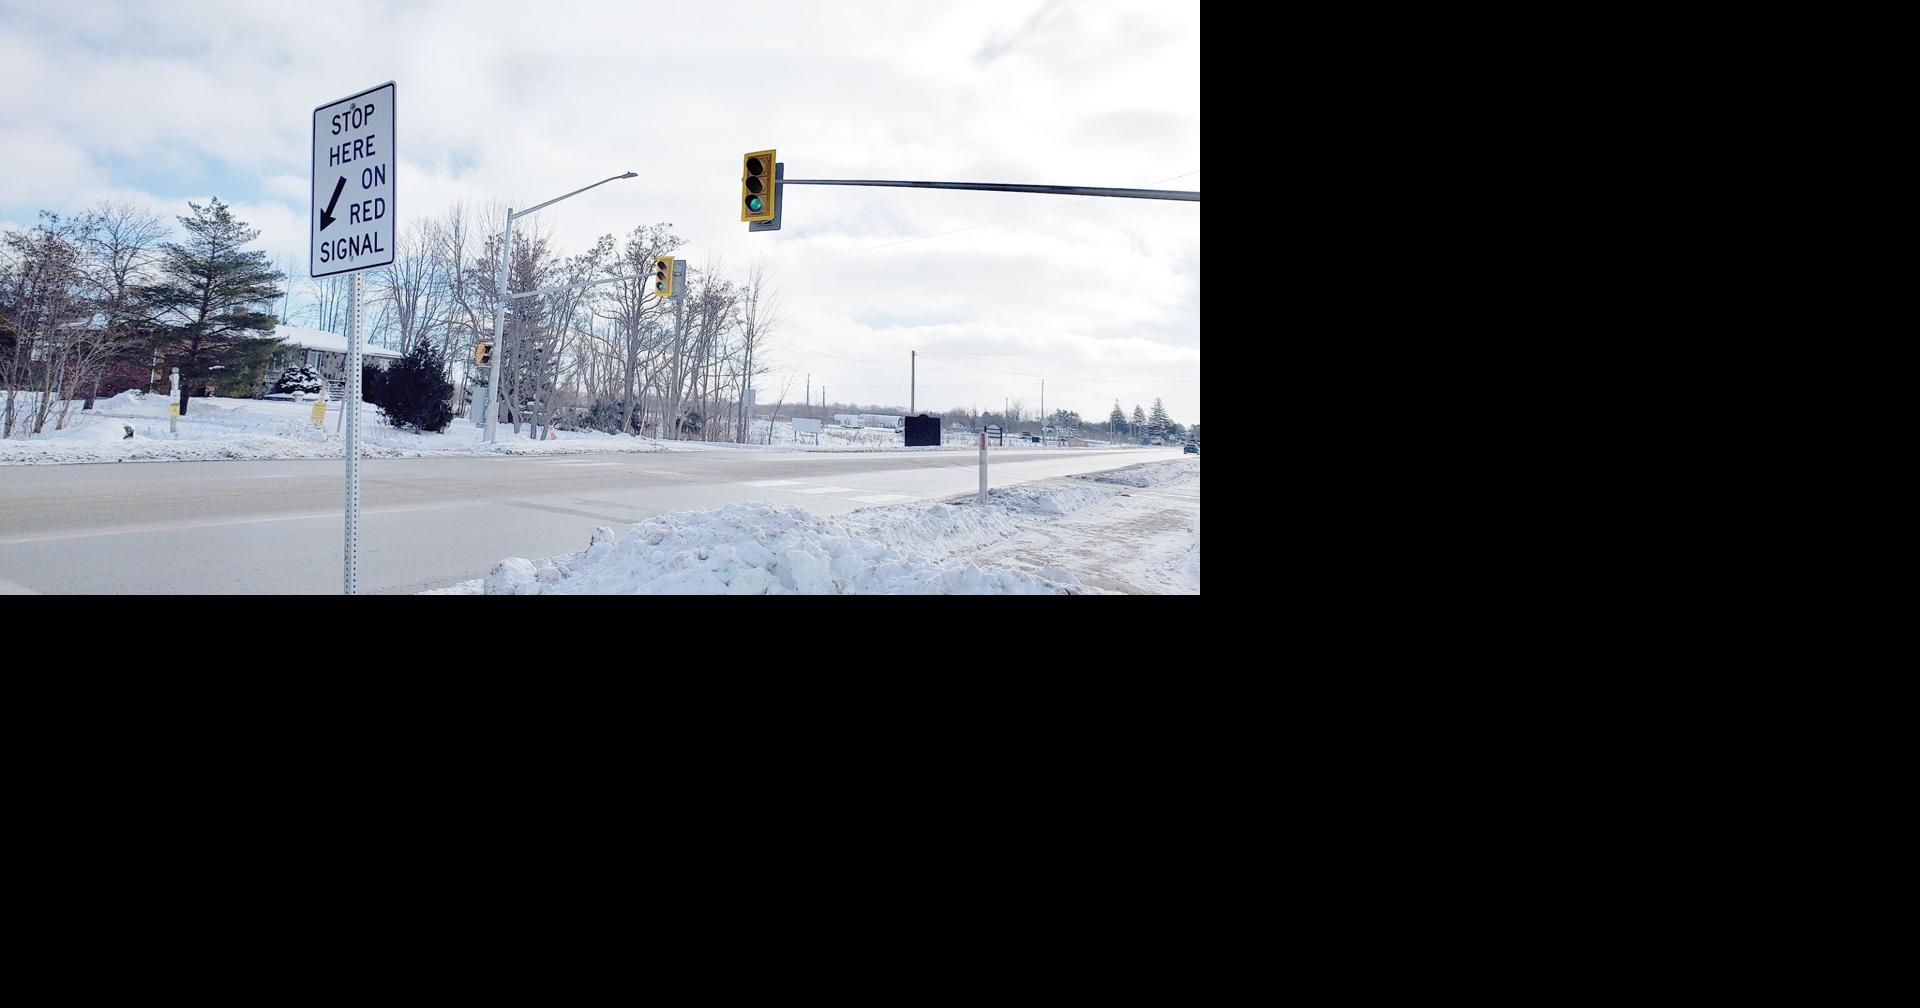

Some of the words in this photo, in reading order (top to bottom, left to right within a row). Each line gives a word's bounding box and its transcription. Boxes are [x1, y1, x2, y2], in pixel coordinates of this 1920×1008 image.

[331, 103, 375, 135] STOP
[329, 135, 376, 167] HERE
[361, 163, 386, 189] ON
[350, 197, 386, 225] RED
[320, 231, 385, 263] SIGNAL
